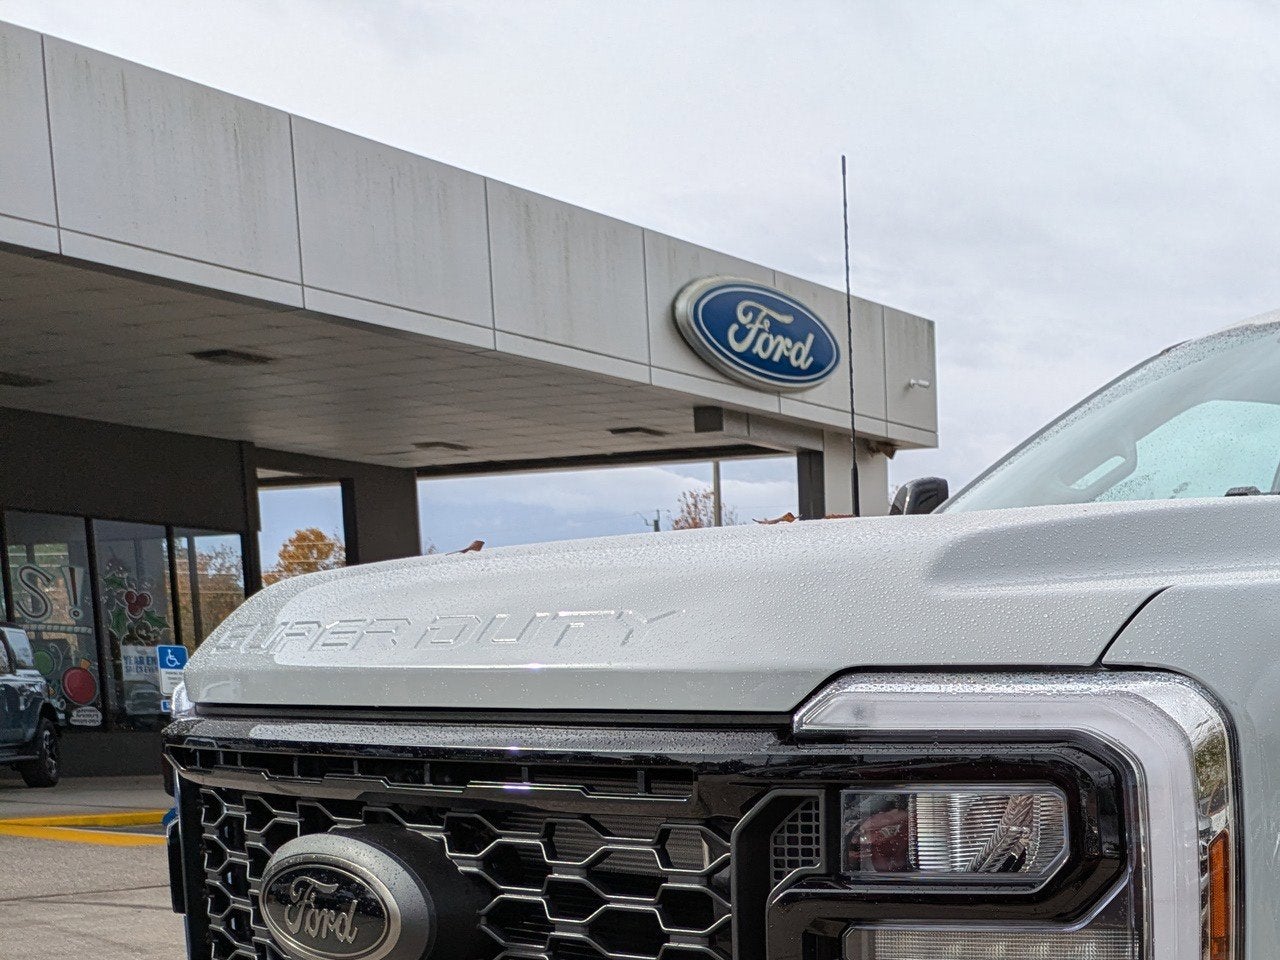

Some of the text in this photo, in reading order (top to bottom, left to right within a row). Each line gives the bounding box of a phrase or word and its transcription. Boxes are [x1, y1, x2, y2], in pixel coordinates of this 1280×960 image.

[727, 300, 814, 370] Ford
[211, 609, 686, 655] SUPER DUTY
[284, 876, 358, 944] Ford
